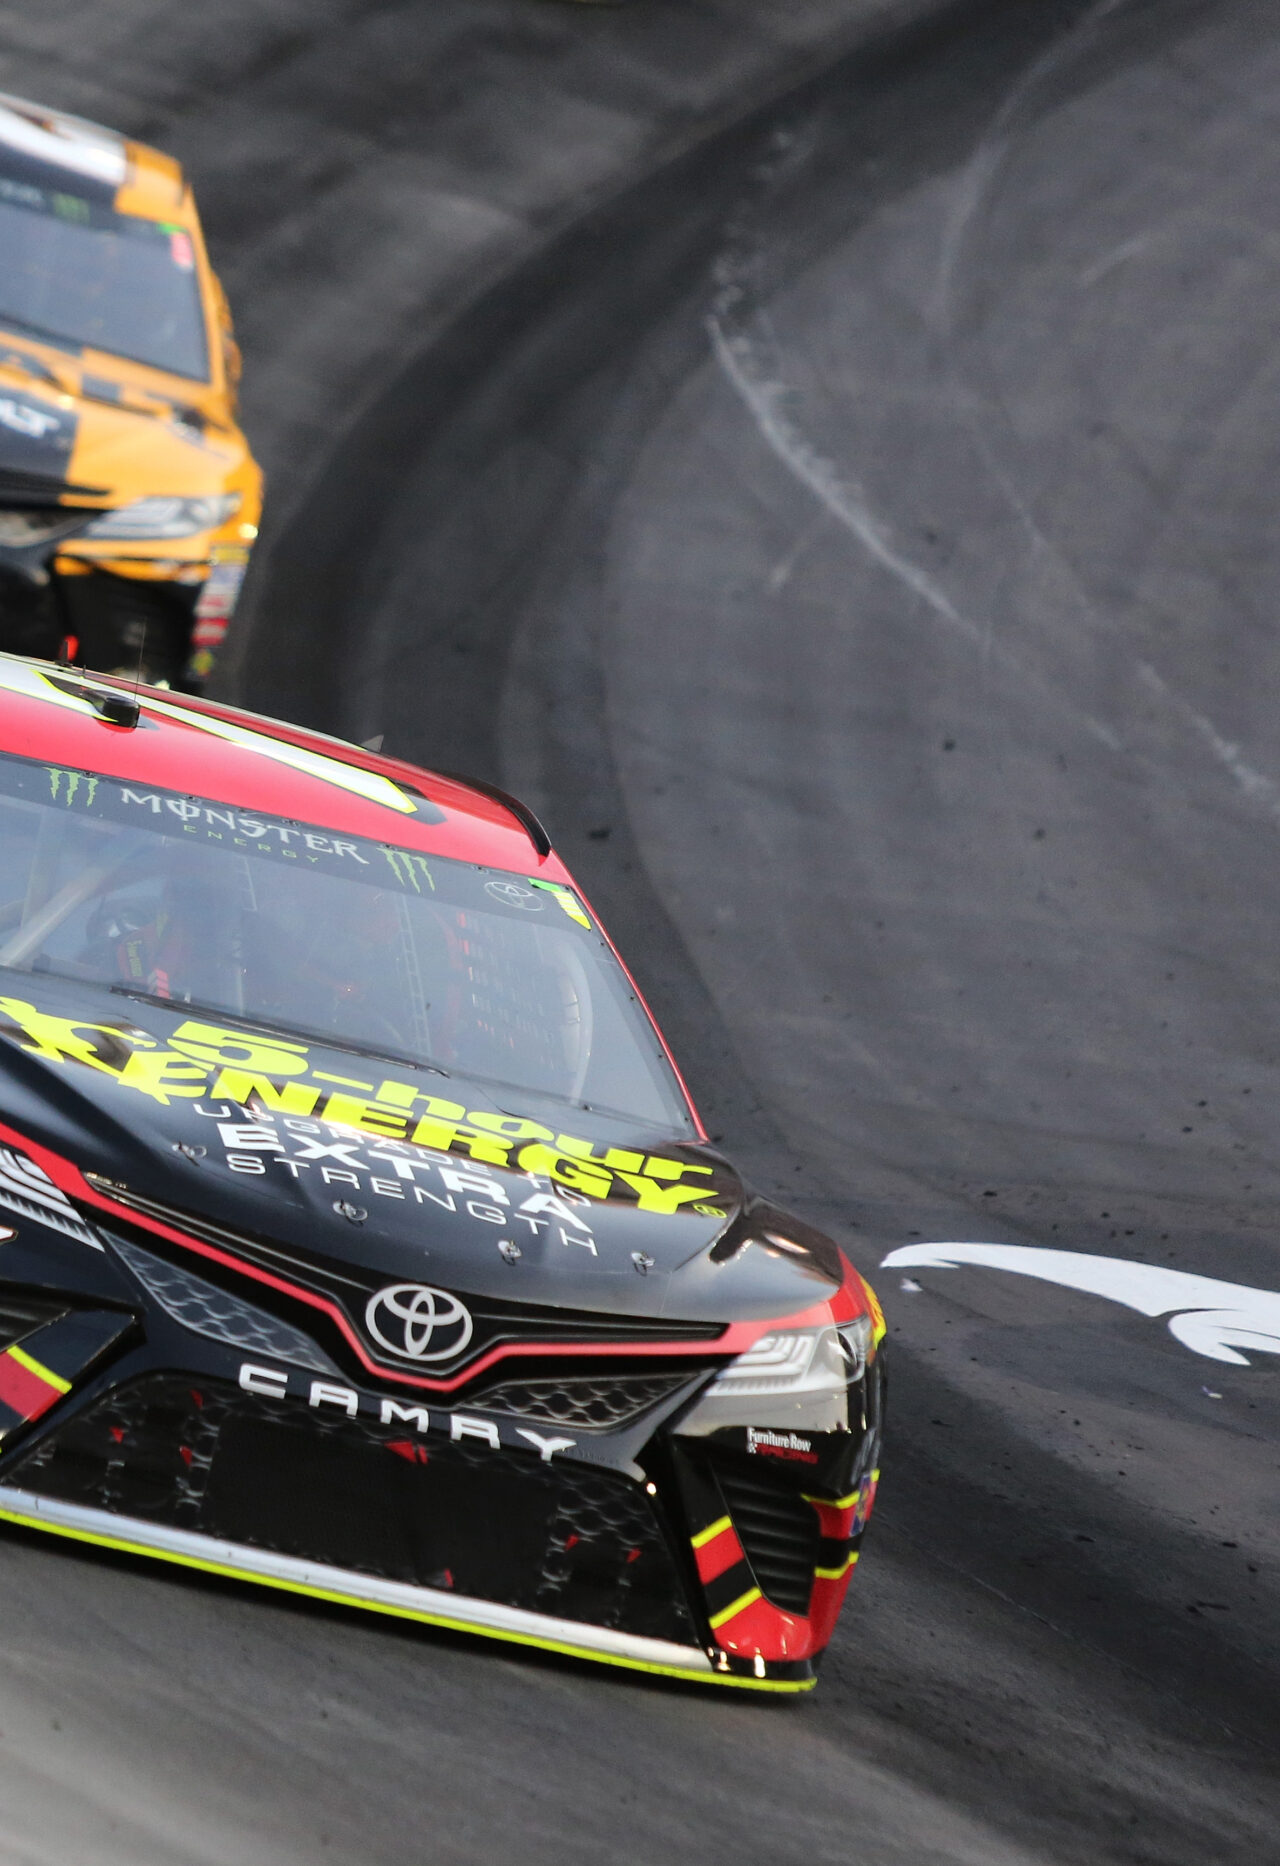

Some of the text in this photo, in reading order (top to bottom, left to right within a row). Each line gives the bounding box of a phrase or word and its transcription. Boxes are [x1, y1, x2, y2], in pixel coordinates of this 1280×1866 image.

[120, 787, 370, 864] MONSTER
[183, 824, 319, 863] ENERGY
[120, 1050, 720, 1215] ENERGY
[217, 1122, 593, 1234] EXTRA
[226, 1153, 598, 1257] STRENGTH
[239, 1362, 578, 1462] CAMRY
[746, 1425, 813, 1452] Furniture Row
